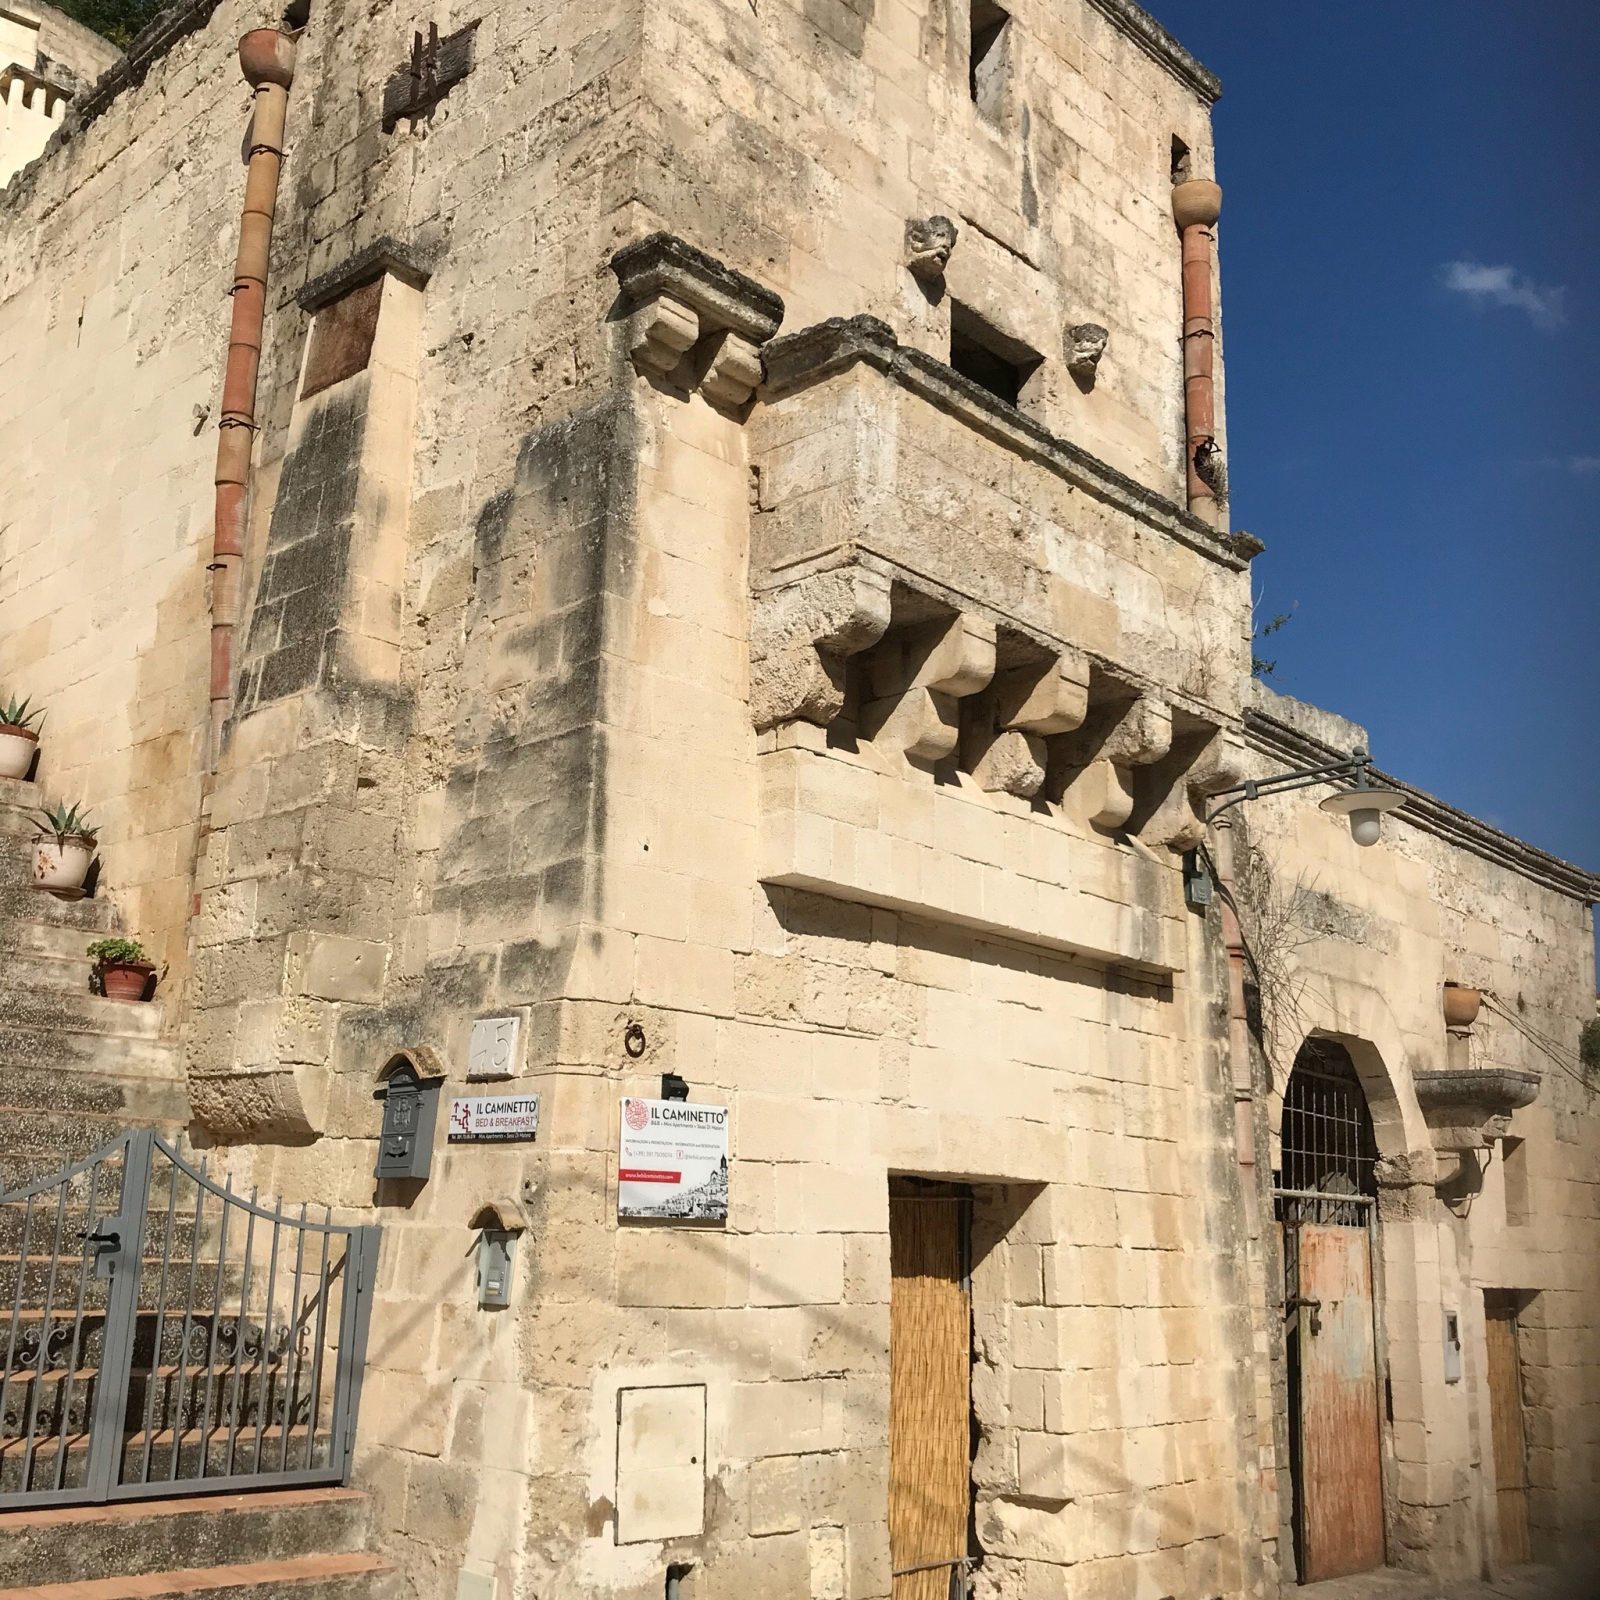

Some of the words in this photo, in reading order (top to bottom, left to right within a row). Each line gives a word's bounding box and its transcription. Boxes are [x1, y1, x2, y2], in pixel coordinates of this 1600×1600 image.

[476, 1103, 484, 1114] IL
[485, 1100, 537, 1114] CAMINETTO
[475, 1118, 489, 1128] BED
[495, 1116, 535, 1127] BREAKFAST
[651, 1107, 660, 1119] IL
[662, 1108, 724, 1124] CAMINETTO
